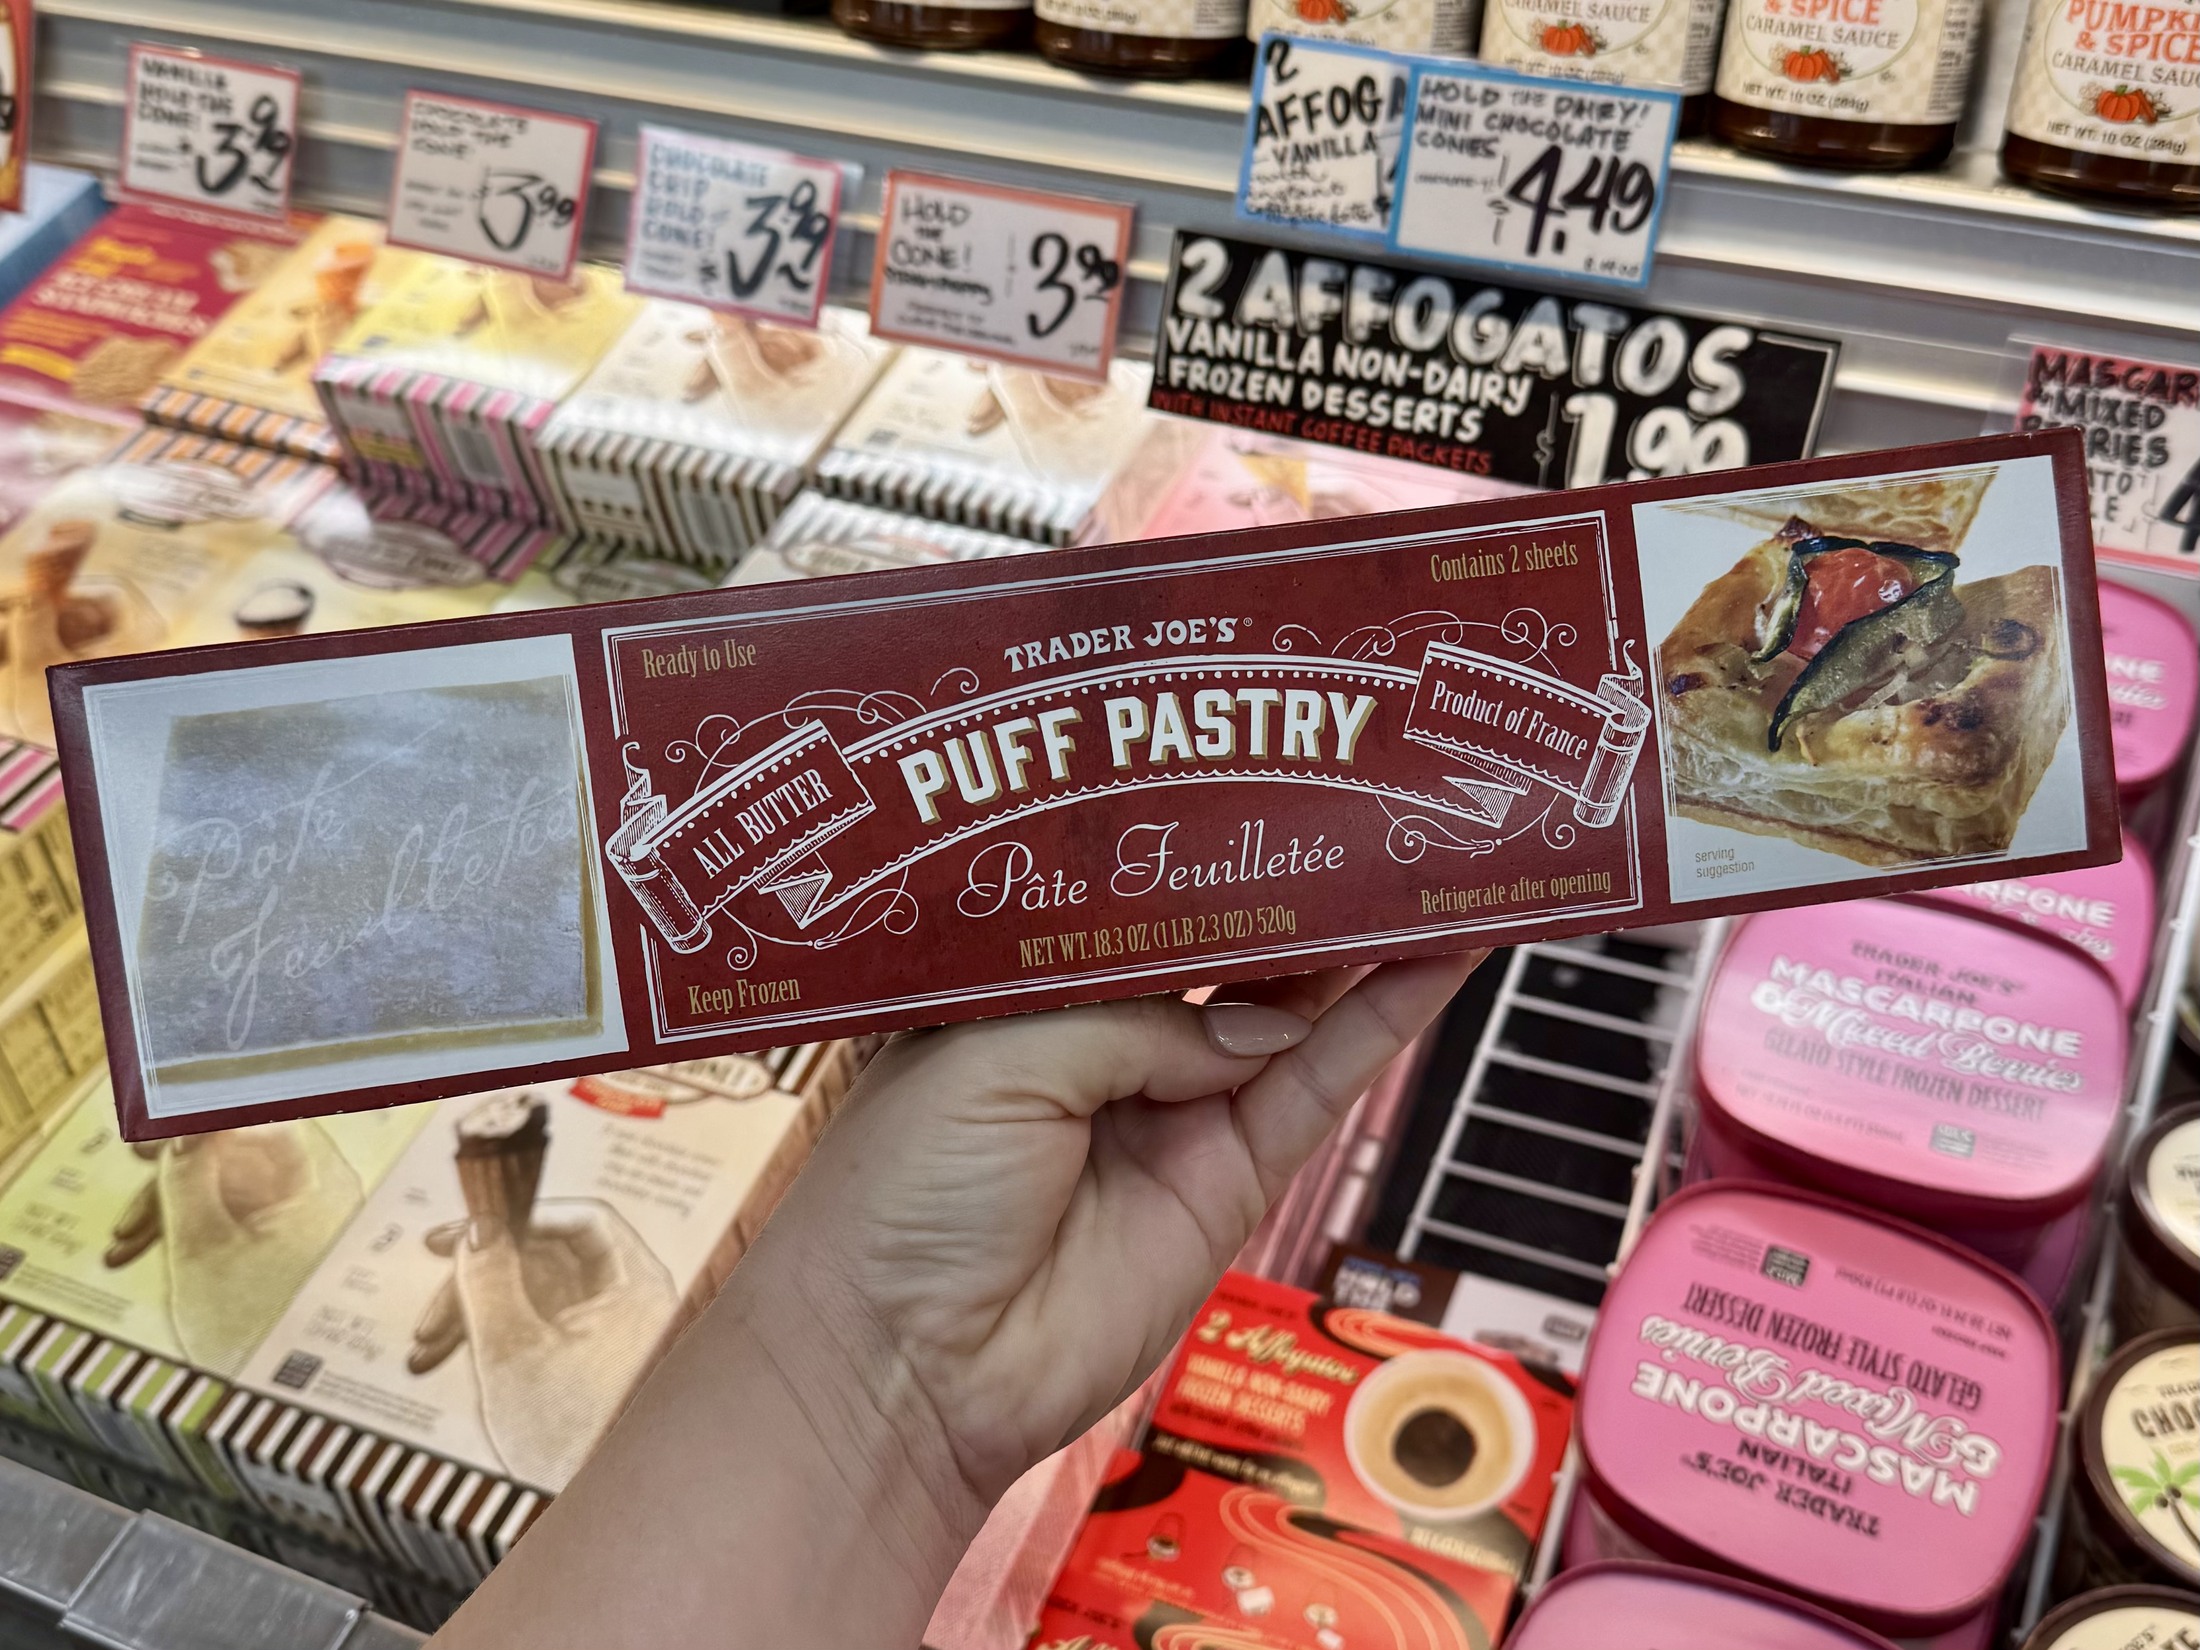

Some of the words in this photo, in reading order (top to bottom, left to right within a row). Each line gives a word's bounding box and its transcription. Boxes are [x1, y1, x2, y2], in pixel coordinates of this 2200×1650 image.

[1587, 3, 1651, 25] SAUCE
[1745, 14, 1827, 43] CARAMEL
[1831, 25, 1901, 49] SAUCE
[1264, 39, 1298, 86] 2
[2075, 31, 2096, 51] &
[2051, 50, 2147, 82] CARAMEL
[1420, 78, 1500, 108] HOLD
[1271, 131, 1378, 165] VANILLA
[1415, 105, 1473, 131] MINI
[1484, 112, 1632, 152] CHOCOLATE
[1415, 130, 1500, 159] CONES
[2047, 121, 2069, 136] NET
[902, 195, 970, 227] HOLD
[1177, 237, 1230, 320] 2
[1235, 250, 1752, 420] AFFOGATOS
[1166, 315, 1325, 376] VANILLA
[1332, 342, 1534, 417] NON-DAIRY
[1169, 356, 1295, 406] FROZEN
[1302, 379, 1484, 444] DESSERTS
[1208, 402, 1299, 434] INSTANT
[1301, 415, 1381, 454] COFFEE
[1386, 437, 1494, 476] PACKETS
[1430, 549, 1505, 583] Contains
[1509, 545, 1520, 573] 2
[1525, 540, 1579, 571] sheets
[642, 645, 698, 679] Ready
[703, 645, 721, 672] to
[724, 639, 757, 668] Use
[1003, 624, 1135, 673] TRADER
[1429, 680, 1504, 728] Product
[1504, 706, 1529, 734] of
[1524, 709, 1589, 760] France
[897, 706, 1084, 826] PUFF
[1104, 688, 1378, 770] PASTRY
[692, 827, 746, 879] ALL
[735, 767, 833, 845] BUTTER
[956, 841, 1088, 918] Pâte
[1110, 818, 1345, 897] Feuilletée
[1695, 847, 1735, 863] serving
[1696, 859, 1755, 879] suggestion
[1420, 881, 1506, 915] Refrigerate
[1509, 876, 1547, 904] after
[1550, 867, 1612, 898] opening
[1019, 936, 1056, 969] NET
[1058, 930, 1093, 963] WT.
[1094, 925, 1124, 959] 18.3
[1127, 922, 1151, 953] OZ
[1153, 924, 1169, 950] (1
[1172, 916, 1195, 947] LB
[1198, 912, 1221, 942] 2.3
[1223, 906, 1253, 940] OZ)
[1255, 904, 1297, 936] 520g
[687, 984, 734, 1016] Keep
[736, 977, 801, 1008] Frozen
[1770, 954, 2085, 1060] MASCARPONE
[1763, 1026, 1833, 1069] GELATO
[1836, 1048, 1887, 1086] STYLE
[1889, 1063, 1965, 1108] FROZEN
[1967, 1080, 2046, 1121] DESSERT
[1682, 1281, 1765, 1334] DESSERT
[1763, 1308, 1843, 1364] FROZEN
[1847, 1336, 1906, 1385] STYLE
[1908, 1358, 1983, 1412] GELATO
[1630, 1361, 1981, 1517] MASCARPONE
[1737, 1437, 1856, 1496] ITALIAN
[1774, 1484, 1882, 1538] TRADER
